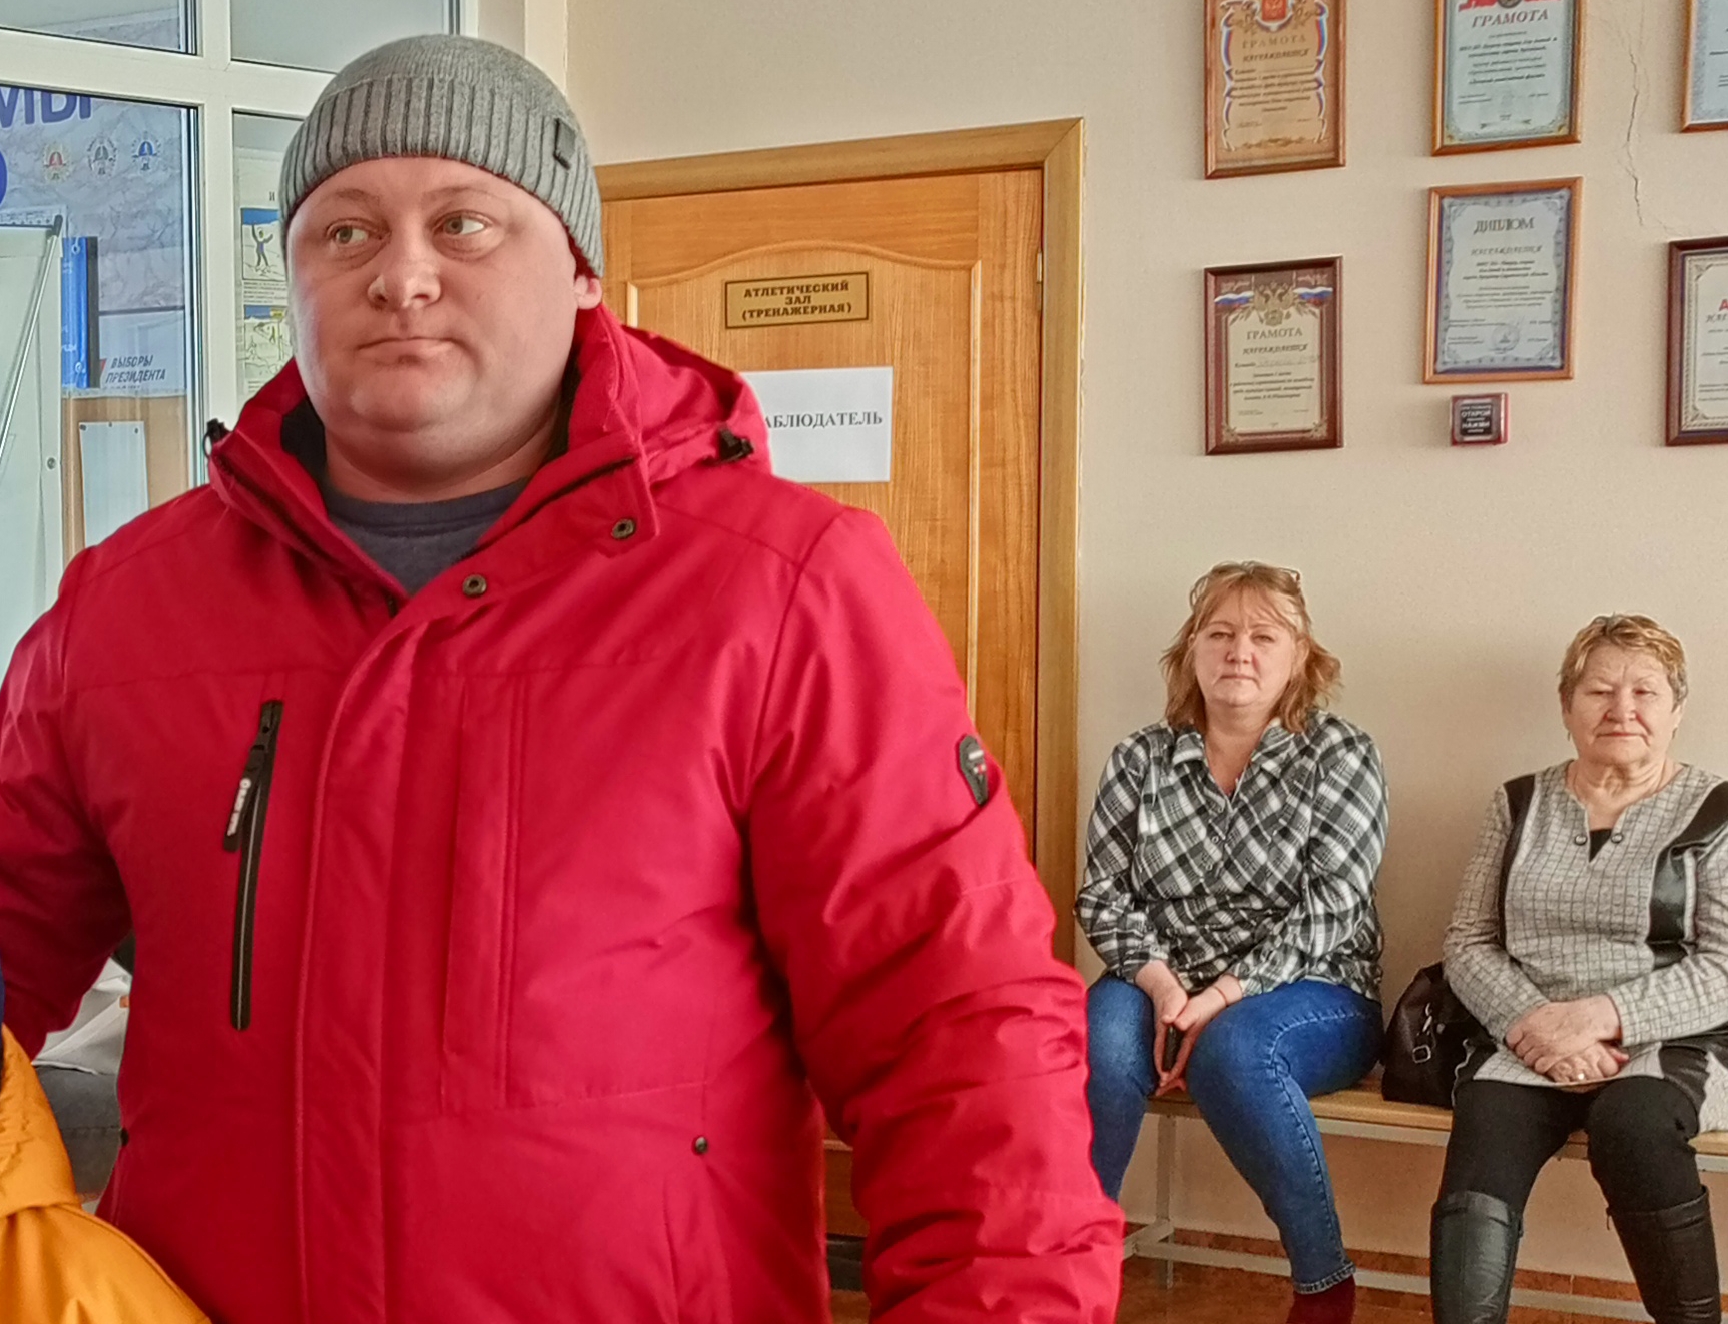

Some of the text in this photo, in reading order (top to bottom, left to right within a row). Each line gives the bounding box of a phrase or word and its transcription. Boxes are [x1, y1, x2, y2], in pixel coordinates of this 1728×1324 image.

[1472, 9, 1549, 28] ГРАМОТА
[1474, 217, 1536, 234] ДИПЛОМ
[743, 280, 849, 298] АТЛЕТИЧЕСКИЙ
[785, 295, 812, 306] ЗАЛ
[742, 302, 852, 321] (ТРЕНАЖЕРНАЯ)
[1246, 327, 1303, 340] ГРАМОТА
[110, 354, 154, 369] ВЫБОРЫ
[105, 369, 166, 384] ПРЕЗИДЕНТА
